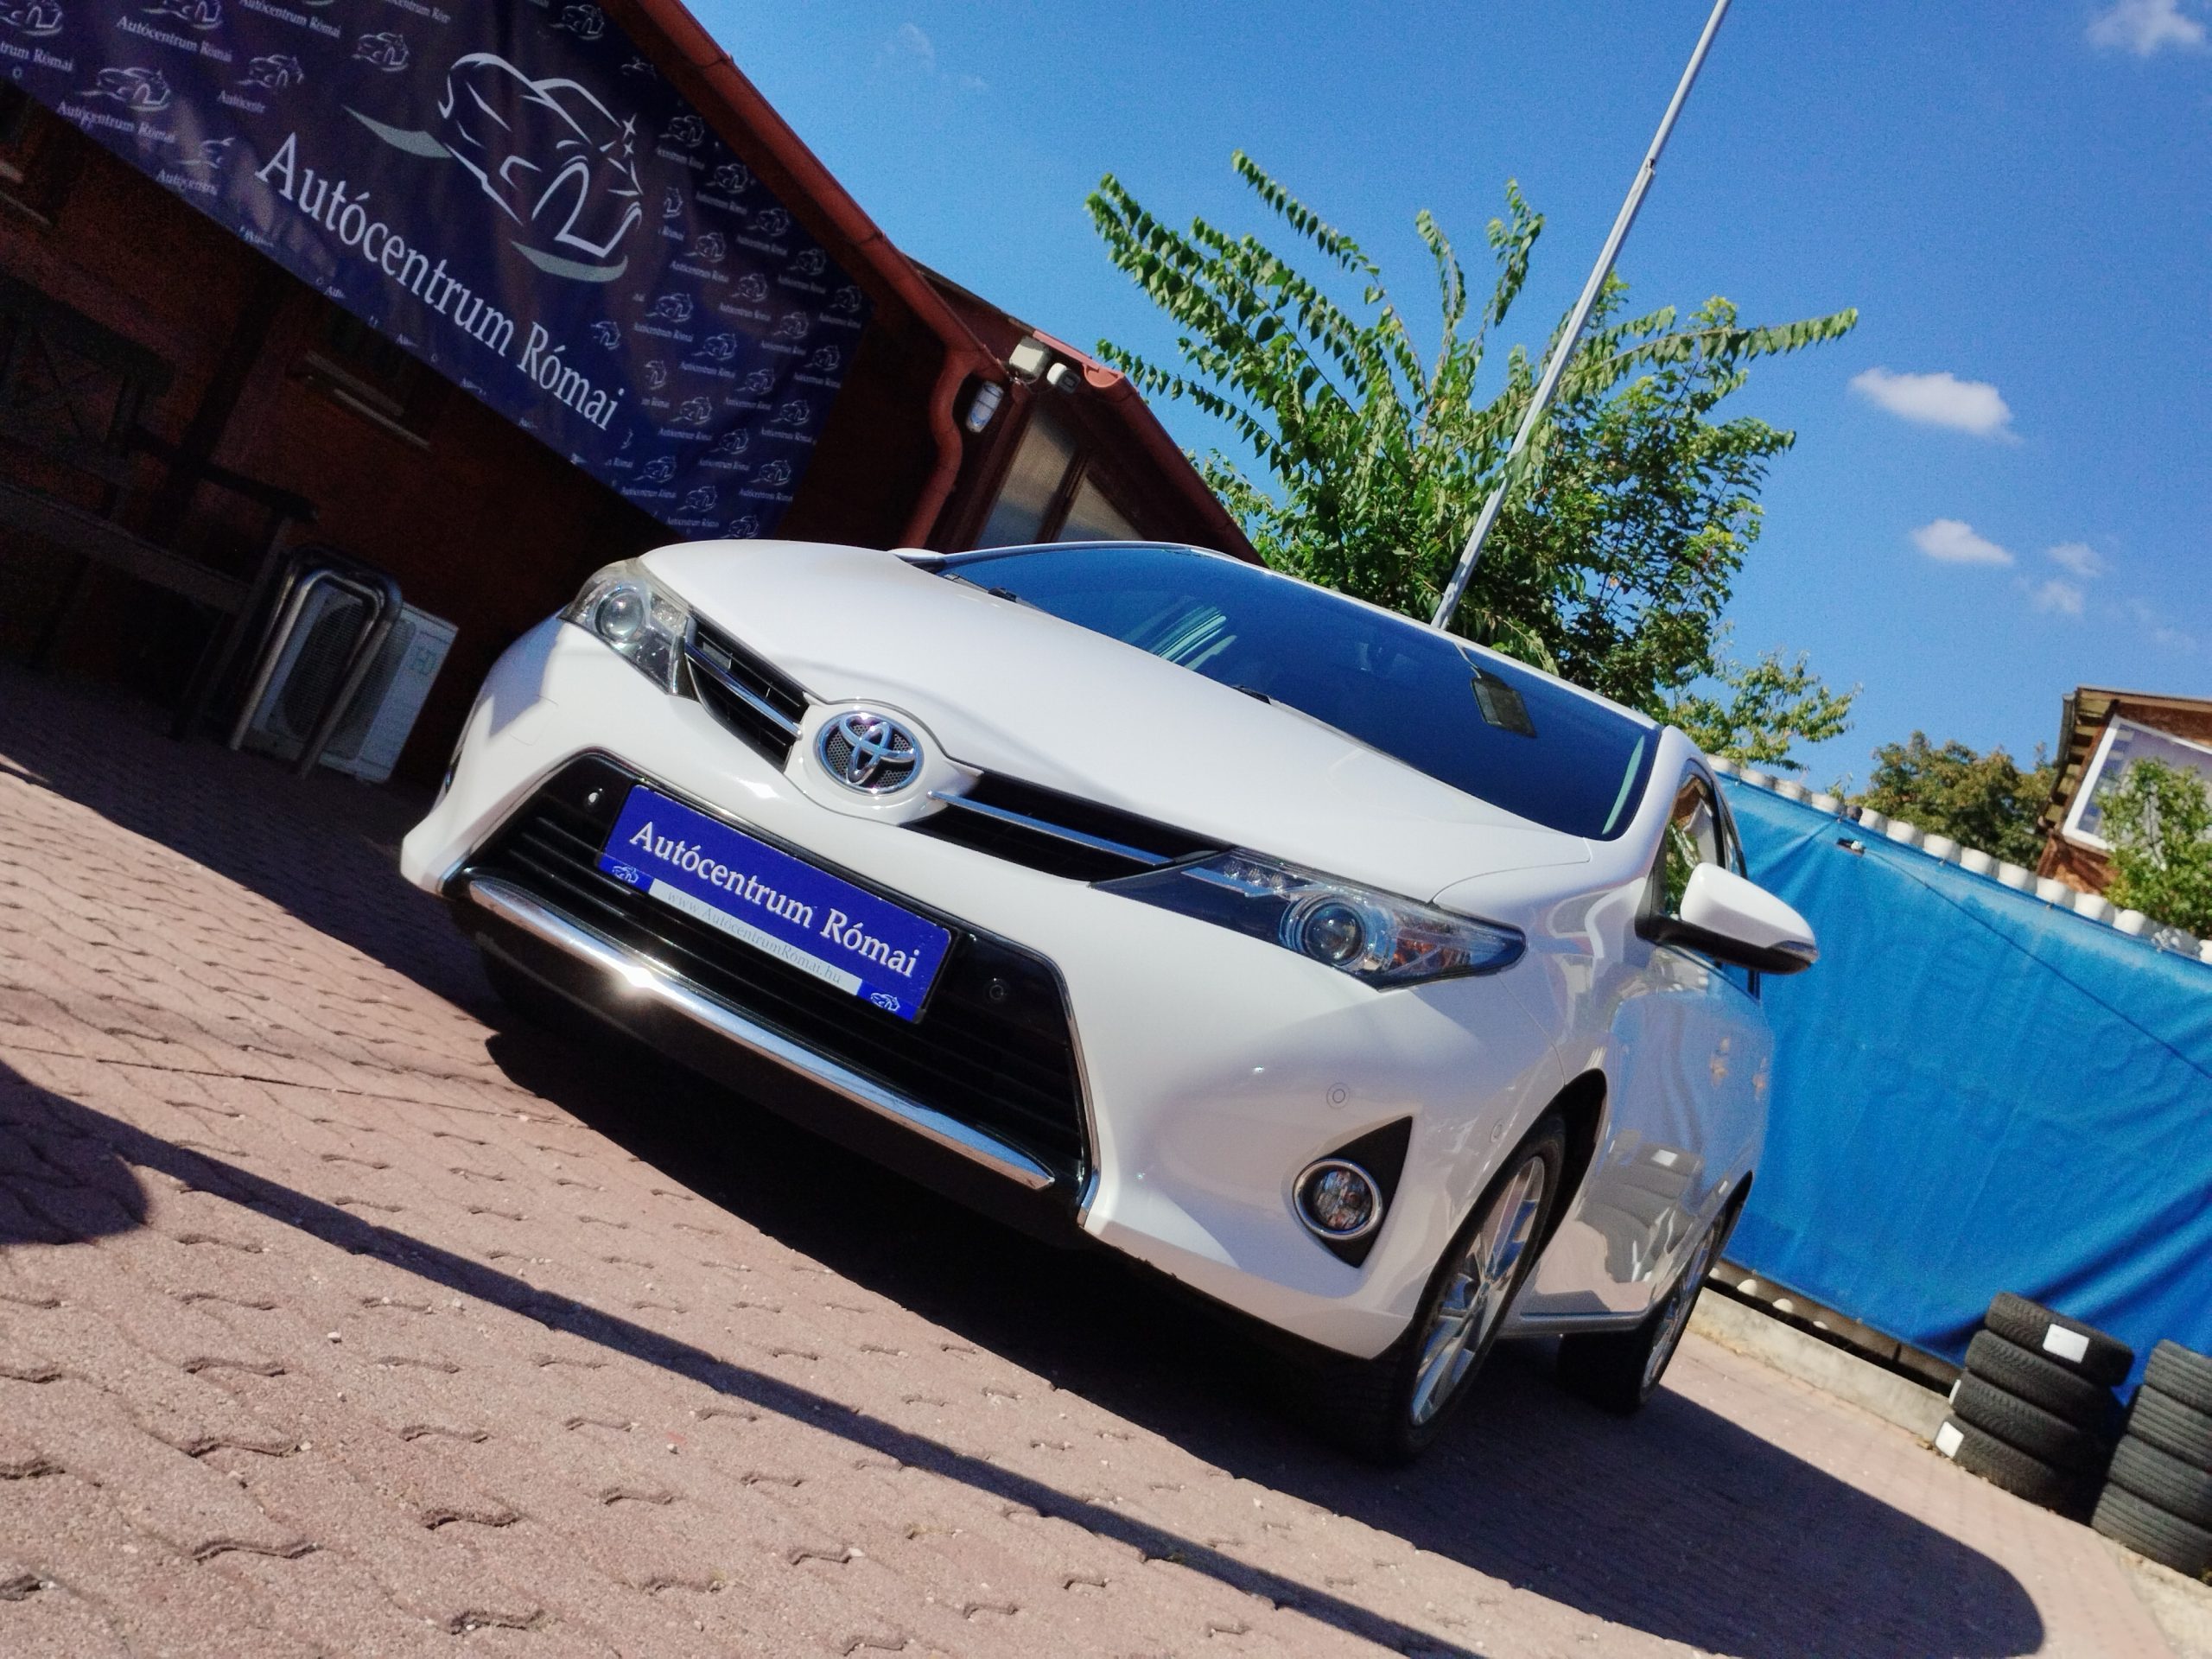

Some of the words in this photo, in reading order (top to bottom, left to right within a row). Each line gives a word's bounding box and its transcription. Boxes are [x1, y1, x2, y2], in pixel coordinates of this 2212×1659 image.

[257, 132, 514, 357] Autócentrum
[517, 321, 625, 430] Római
[629, 821, 814, 929] Autócentrum
[820, 908, 919, 978] Római
[667, 891, 842, 985] www.AutócentrumRómai.hu
